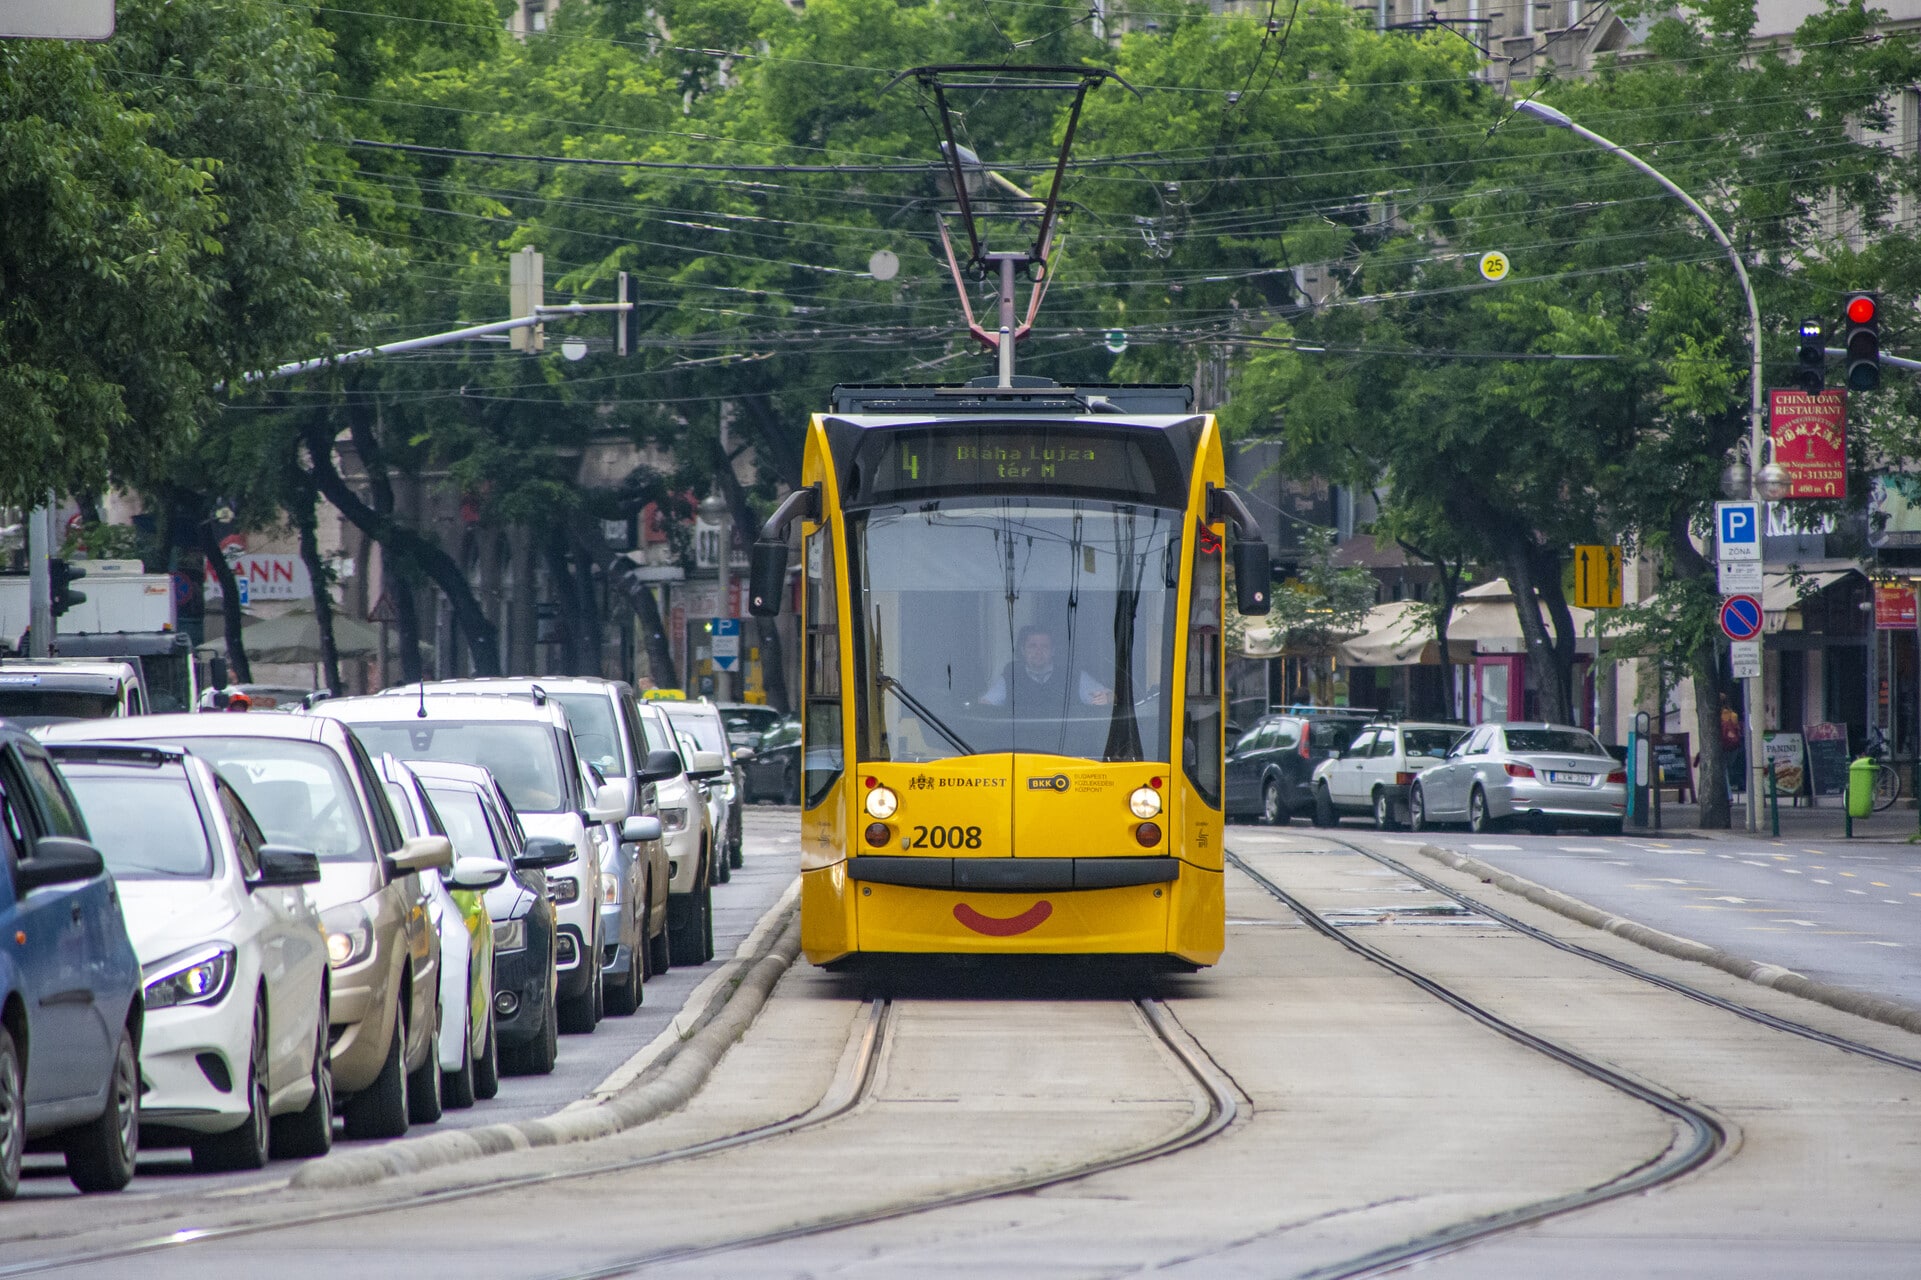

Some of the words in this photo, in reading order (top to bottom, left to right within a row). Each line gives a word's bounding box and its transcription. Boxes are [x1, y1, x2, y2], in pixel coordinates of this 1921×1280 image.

[1487, 259, 1503, 272] 25
[1776, 395, 1841, 404] CHINATOWN
[1776, 406, 1841, 415] RESTAURANT
[957, 443, 1022, 460] Bláha
[1030, 446, 1095, 462] Lujza
[902, 442, 919, 480] 4
[998, 462, 1032, 478] tér
[1041, 463, 1056, 478] M
[1798, 485, 1813, 493] 400
[1729, 512, 1747, 539] P
[1728, 547, 1751, 556] ZÓNA
[719, 620, 732, 635] P
[1766, 744, 1797, 753] PANINI
[938, 778, 1008, 788] BUDAPEST
[912, 825, 982, 850] 2008
